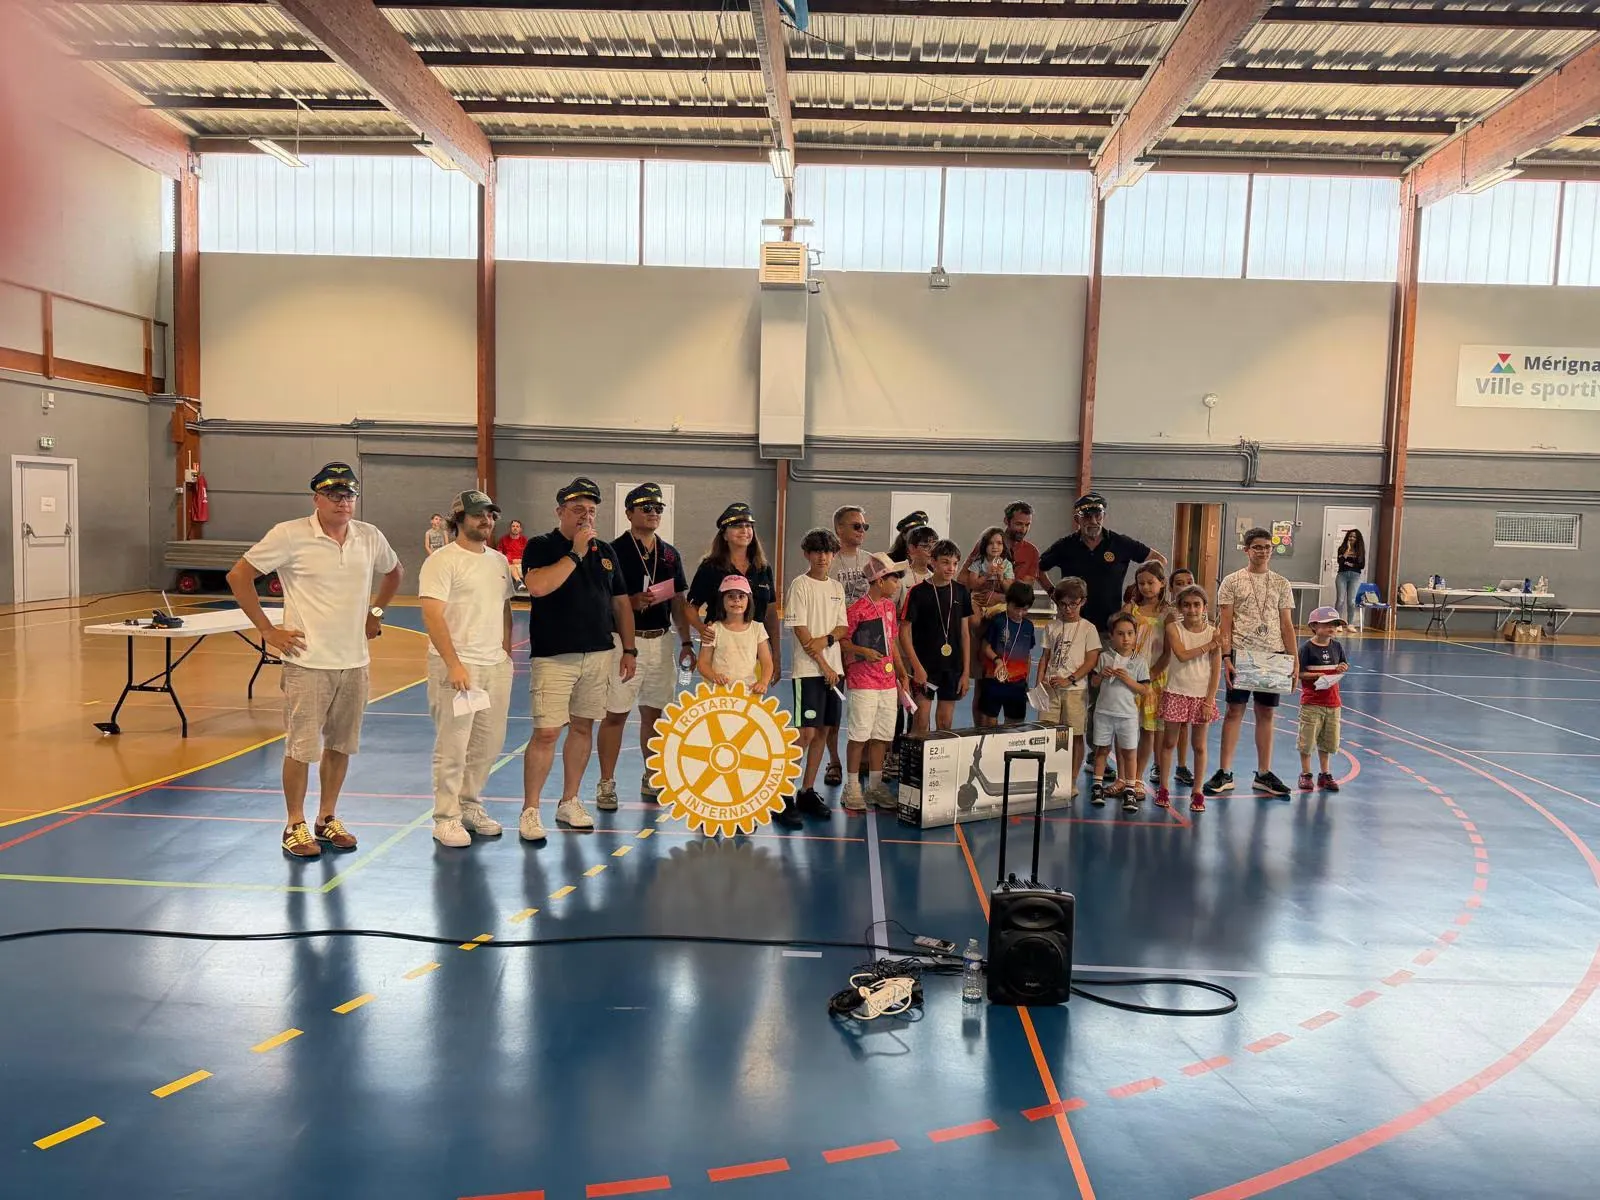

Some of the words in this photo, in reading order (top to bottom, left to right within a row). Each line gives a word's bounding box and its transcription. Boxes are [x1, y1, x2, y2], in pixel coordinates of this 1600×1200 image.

[1475, 377, 1524, 395] Ville
[1530, 379, 1600, 401] sporti
[680, 698, 738, 727] ROTARY
[929, 747, 939, 755] E2
[685, 764, 783, 819] INTERNATIONAL
